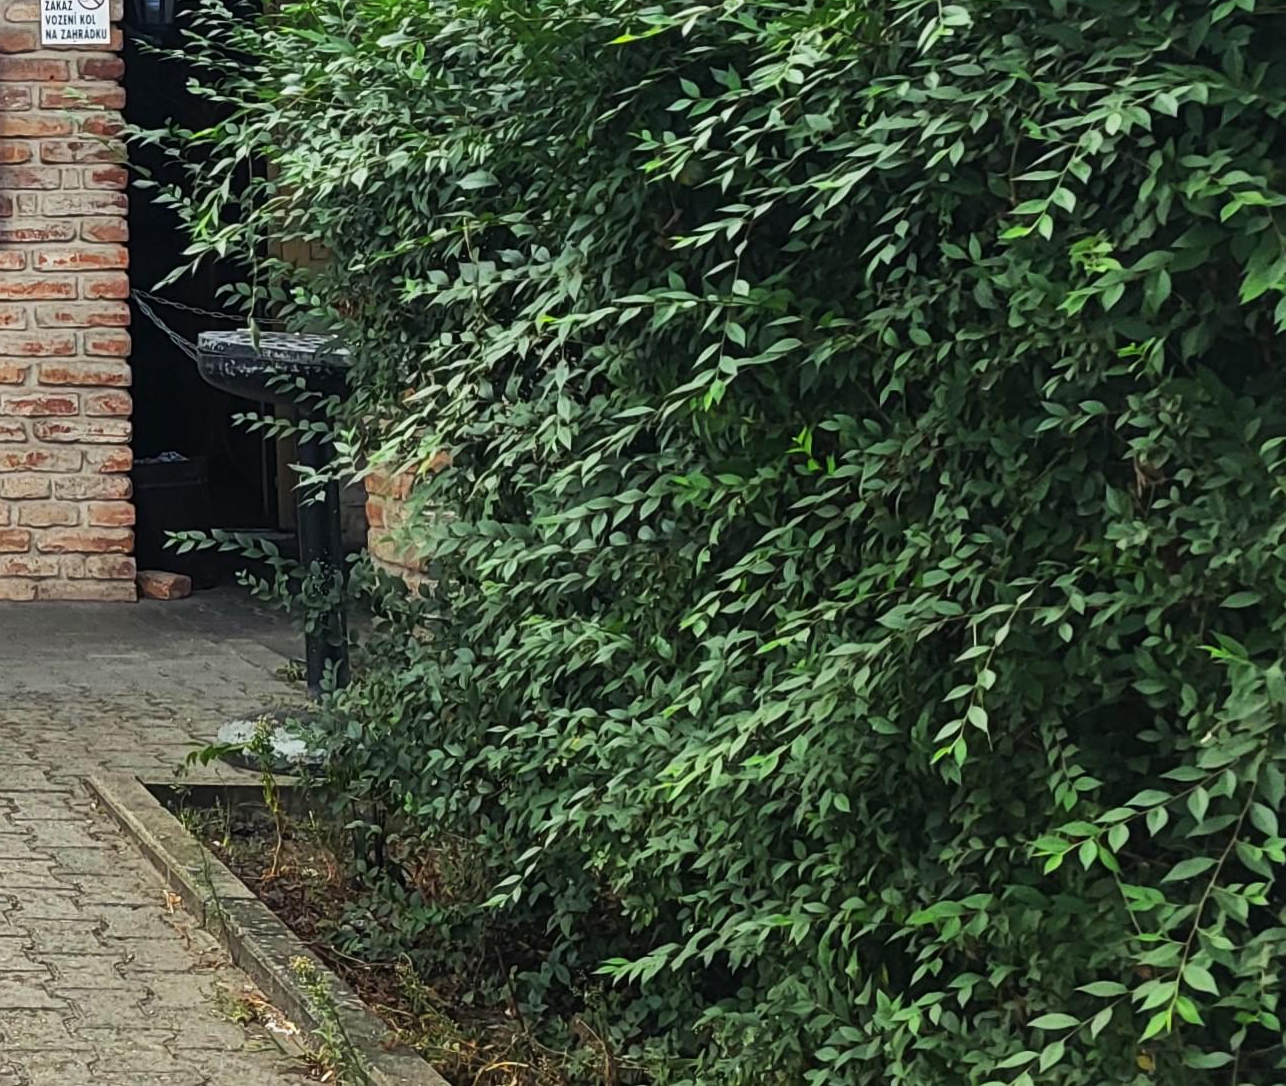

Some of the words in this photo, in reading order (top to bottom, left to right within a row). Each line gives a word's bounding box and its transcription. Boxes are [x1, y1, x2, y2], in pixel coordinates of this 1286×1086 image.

[44, 11, 77, 25] VOZENÍ
[79, 14, 96, 25] KOL
[45, 29, 58, 40] NA
[60, 25, 108, 40] ZAHRÁDKU
